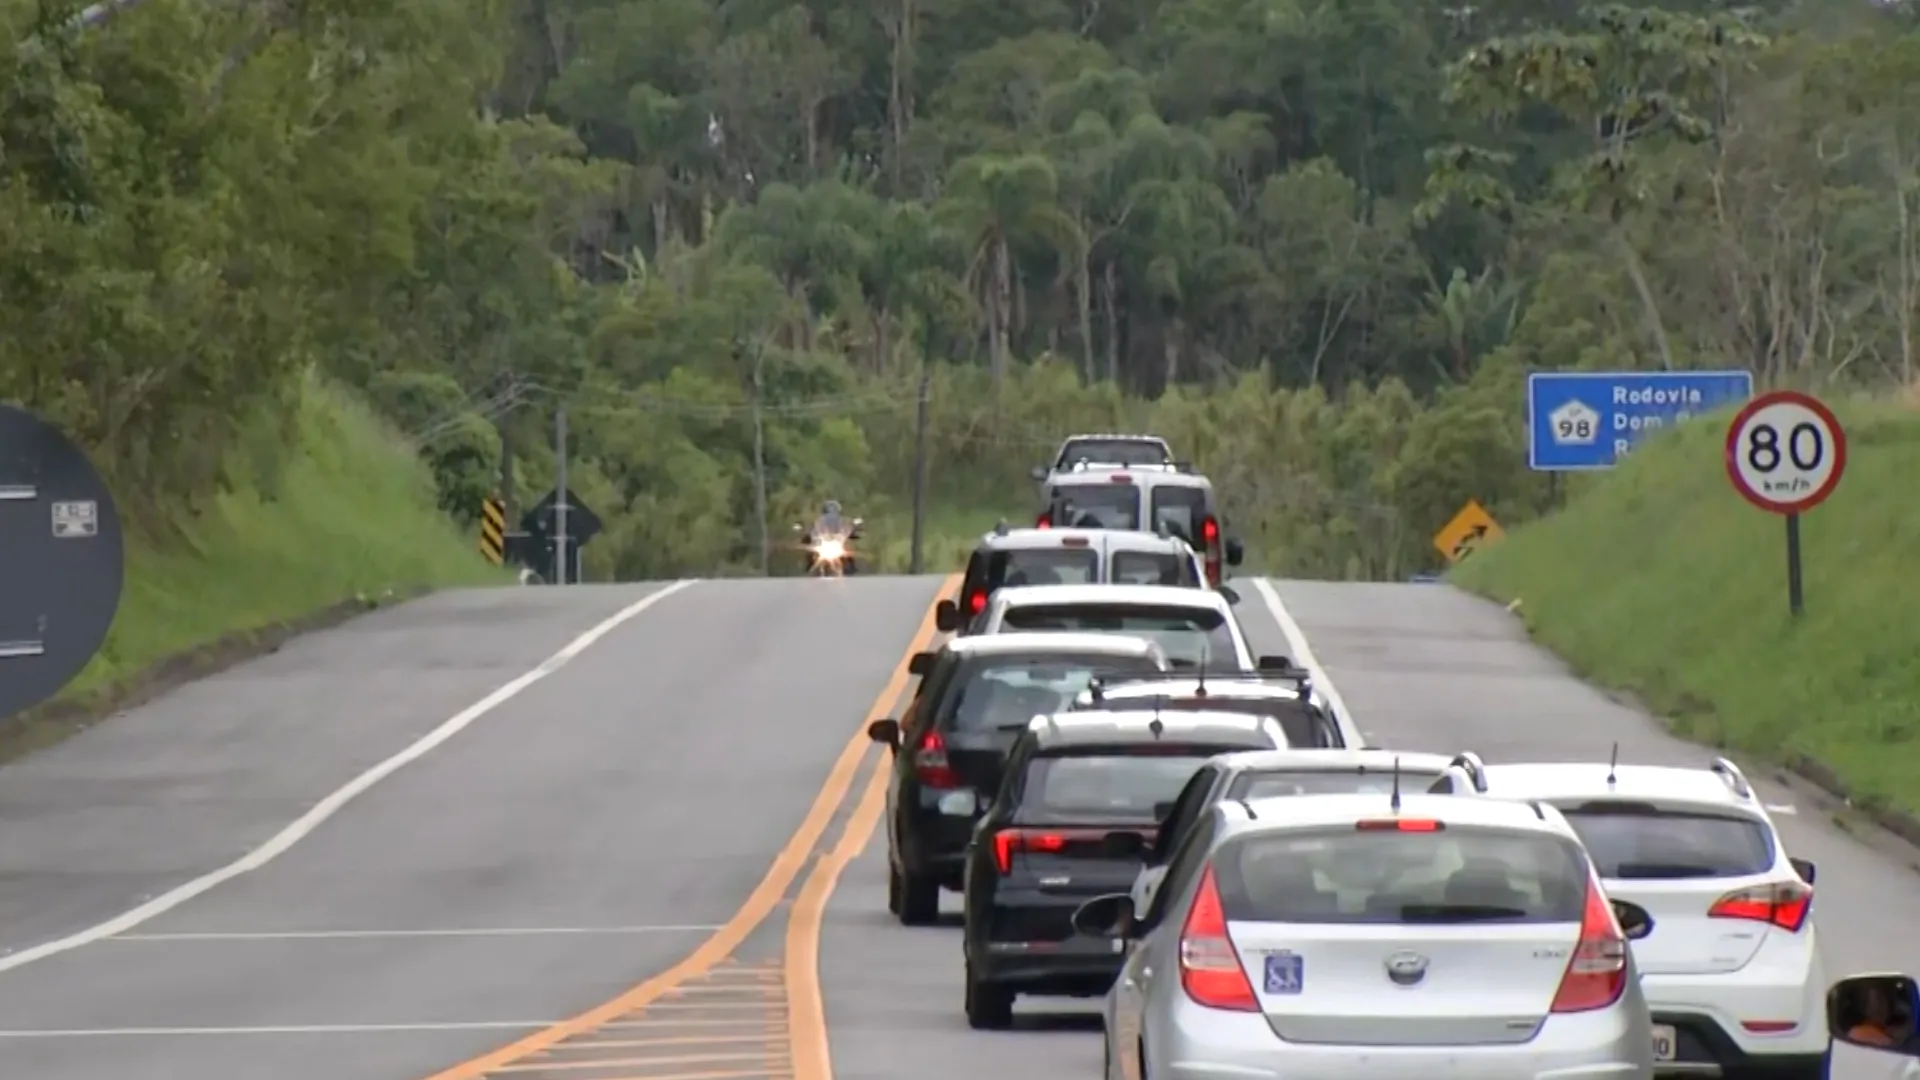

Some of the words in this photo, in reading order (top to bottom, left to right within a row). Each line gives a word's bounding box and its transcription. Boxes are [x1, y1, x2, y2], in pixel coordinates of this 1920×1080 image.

[1613, 386, 1701, 404] Rodovia
[1559, 420, 1590, 438] 98
[1613, 413, 1662, 430] Dom
[1748, 422, 1823, 473] 80
[1763, 477, 1811, 492] km/h
